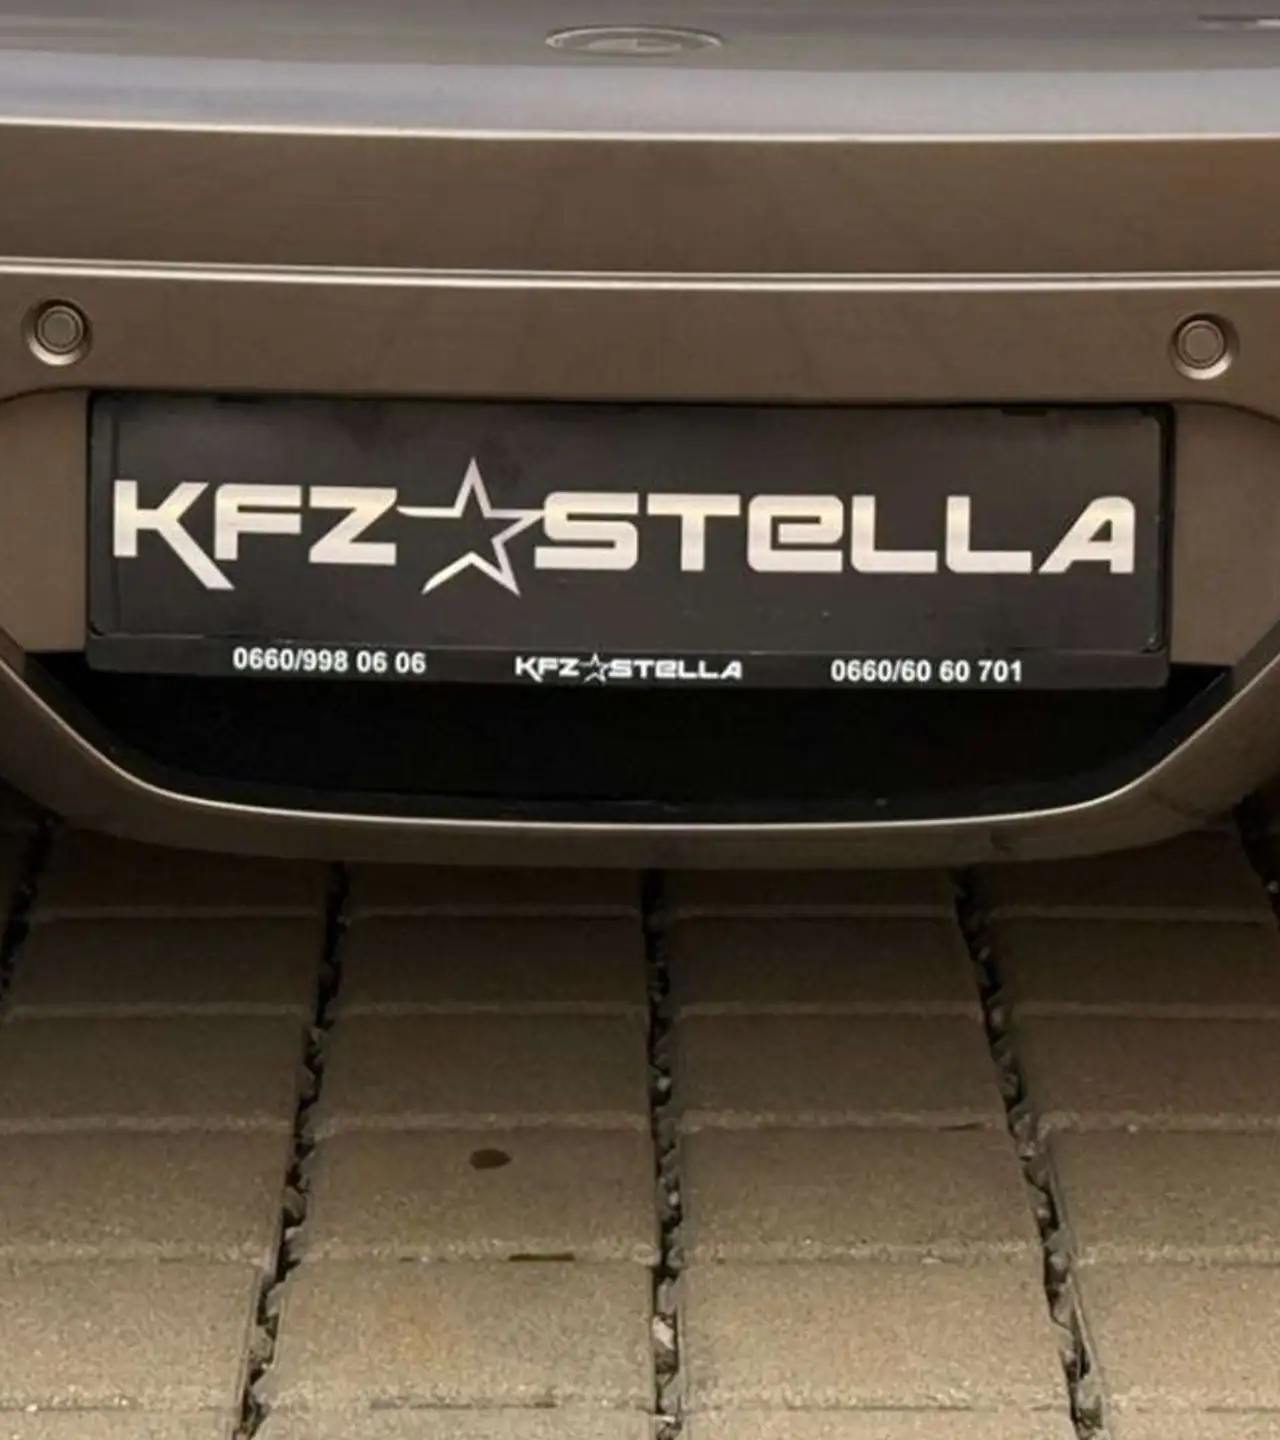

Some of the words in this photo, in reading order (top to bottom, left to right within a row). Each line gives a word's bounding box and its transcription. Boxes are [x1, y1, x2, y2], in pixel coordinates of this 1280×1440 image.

[113, 480, 397, 590] KFZ
[535, 491, 1136, 574] STELLA
[232, 646, 349, 673] 0660/998
[355, 649, 388, 674] 06
[394, 650, 427, 675] 06
[514, 656, 580, 683] KFZ
[608, 658, 743, 680] STELLA
[830, 658, 933, 683] 0660/60
[938, 659, 971, 683] 60
[977, 659, 1022, 683] 701
